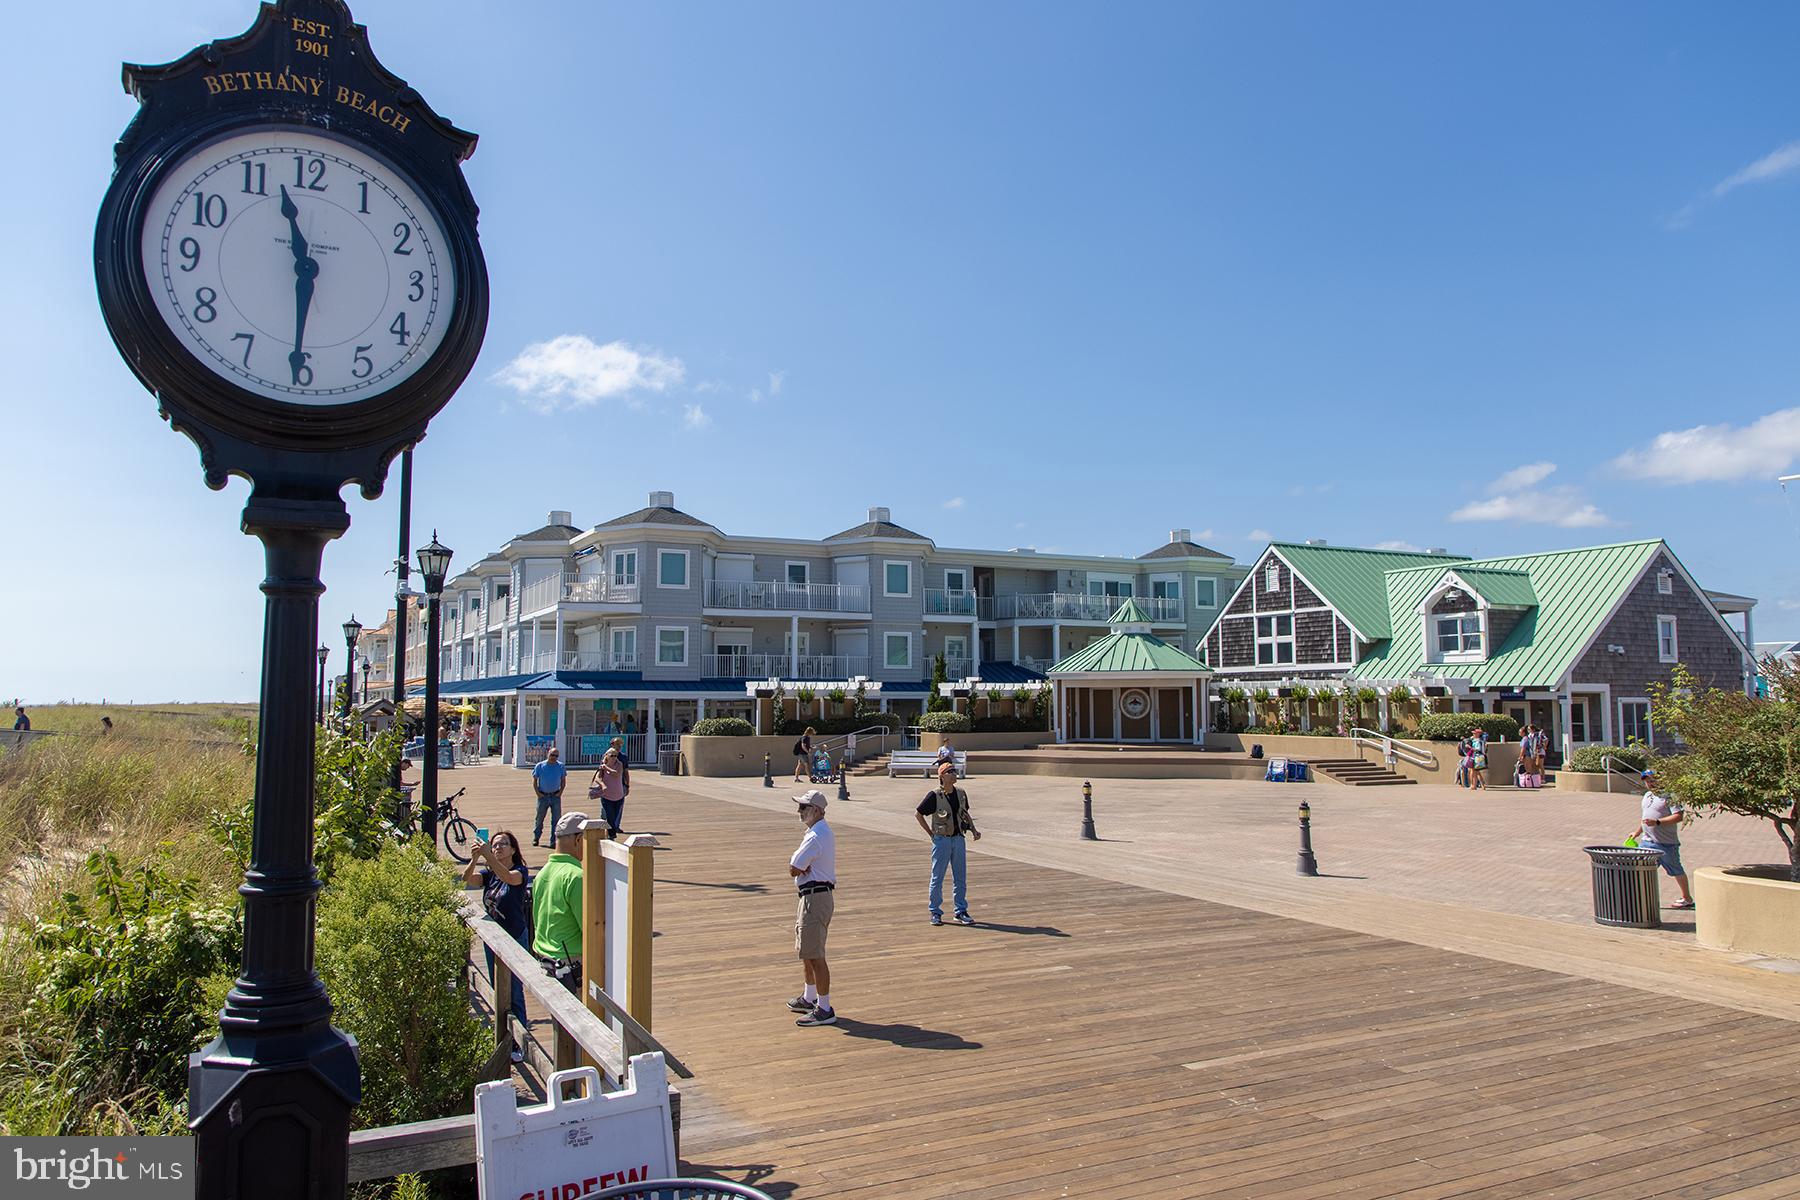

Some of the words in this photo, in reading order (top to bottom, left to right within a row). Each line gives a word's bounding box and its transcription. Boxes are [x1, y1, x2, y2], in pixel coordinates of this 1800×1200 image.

[291, 17, 333, 39] EST.
[295, 38, 330, 58] 1901
[203, 71, 325, 97] BETHANY
[335, 85, 412, 135] BEACH
[240, 160, 269, 197] 11
[293, 155, 328, 192] 12
[191, 191, 228, 229] 10
[357, 181, 372, 215] 1
[179, 236, 201, 272] 9
[311, 243, 340, 252] COMPANY
[392, 222, 414, 256] 2
[407, 269, 425, 302] 3
[193, 286, 218, 324] 8
[388, 311, 411, 346] 4
[229, 332, 256, 370] 7
[296, 351, 314, 387] 6
[351, 343, 374, 379] 5
